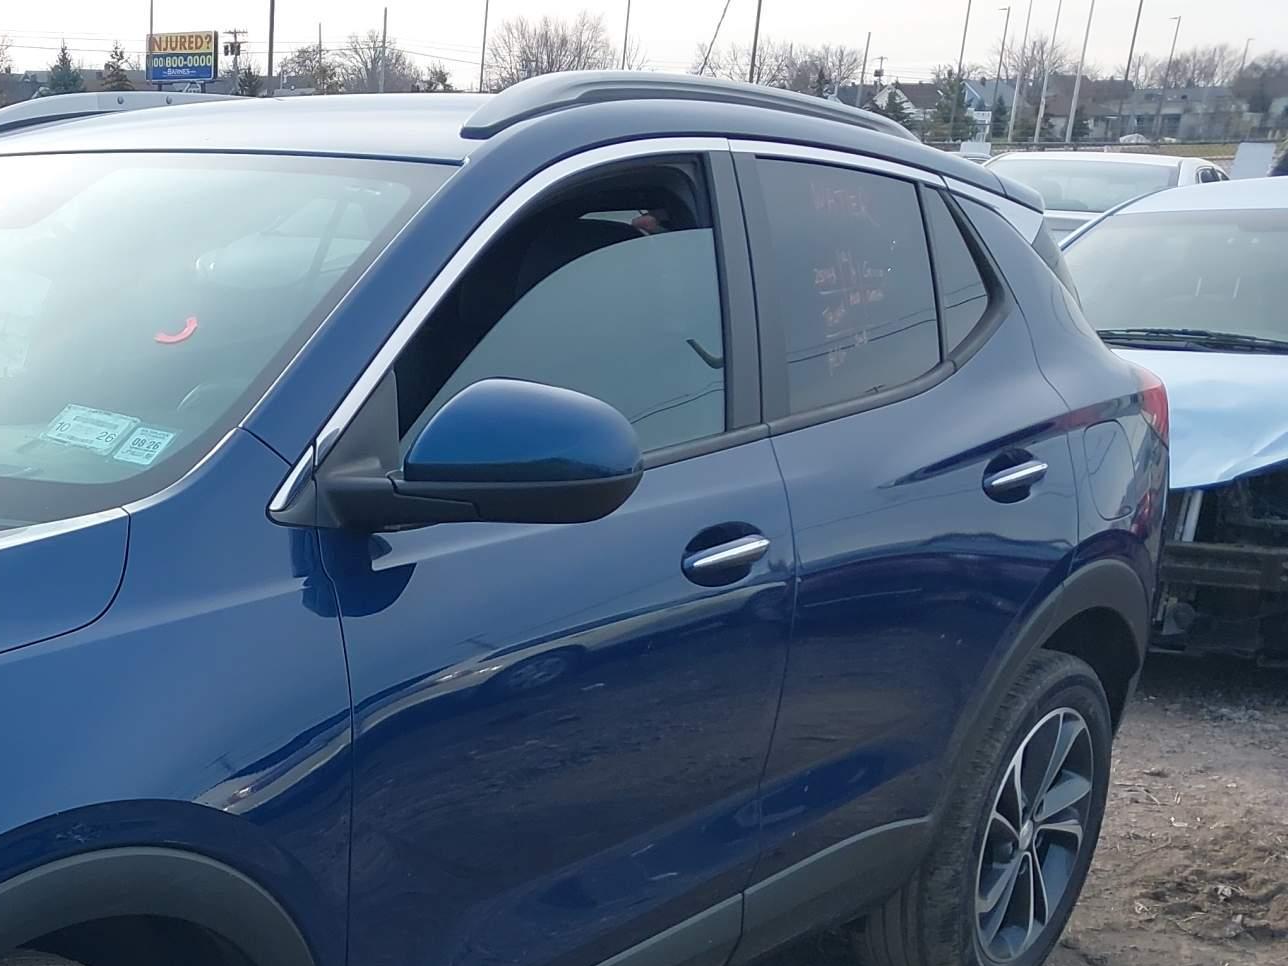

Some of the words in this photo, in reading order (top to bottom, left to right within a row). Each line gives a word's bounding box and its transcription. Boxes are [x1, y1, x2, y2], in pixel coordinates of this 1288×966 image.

[55, 422, 71, 433] 10
[96, 431, 117, 443] 26
[146, 440, 162, 450] 26
